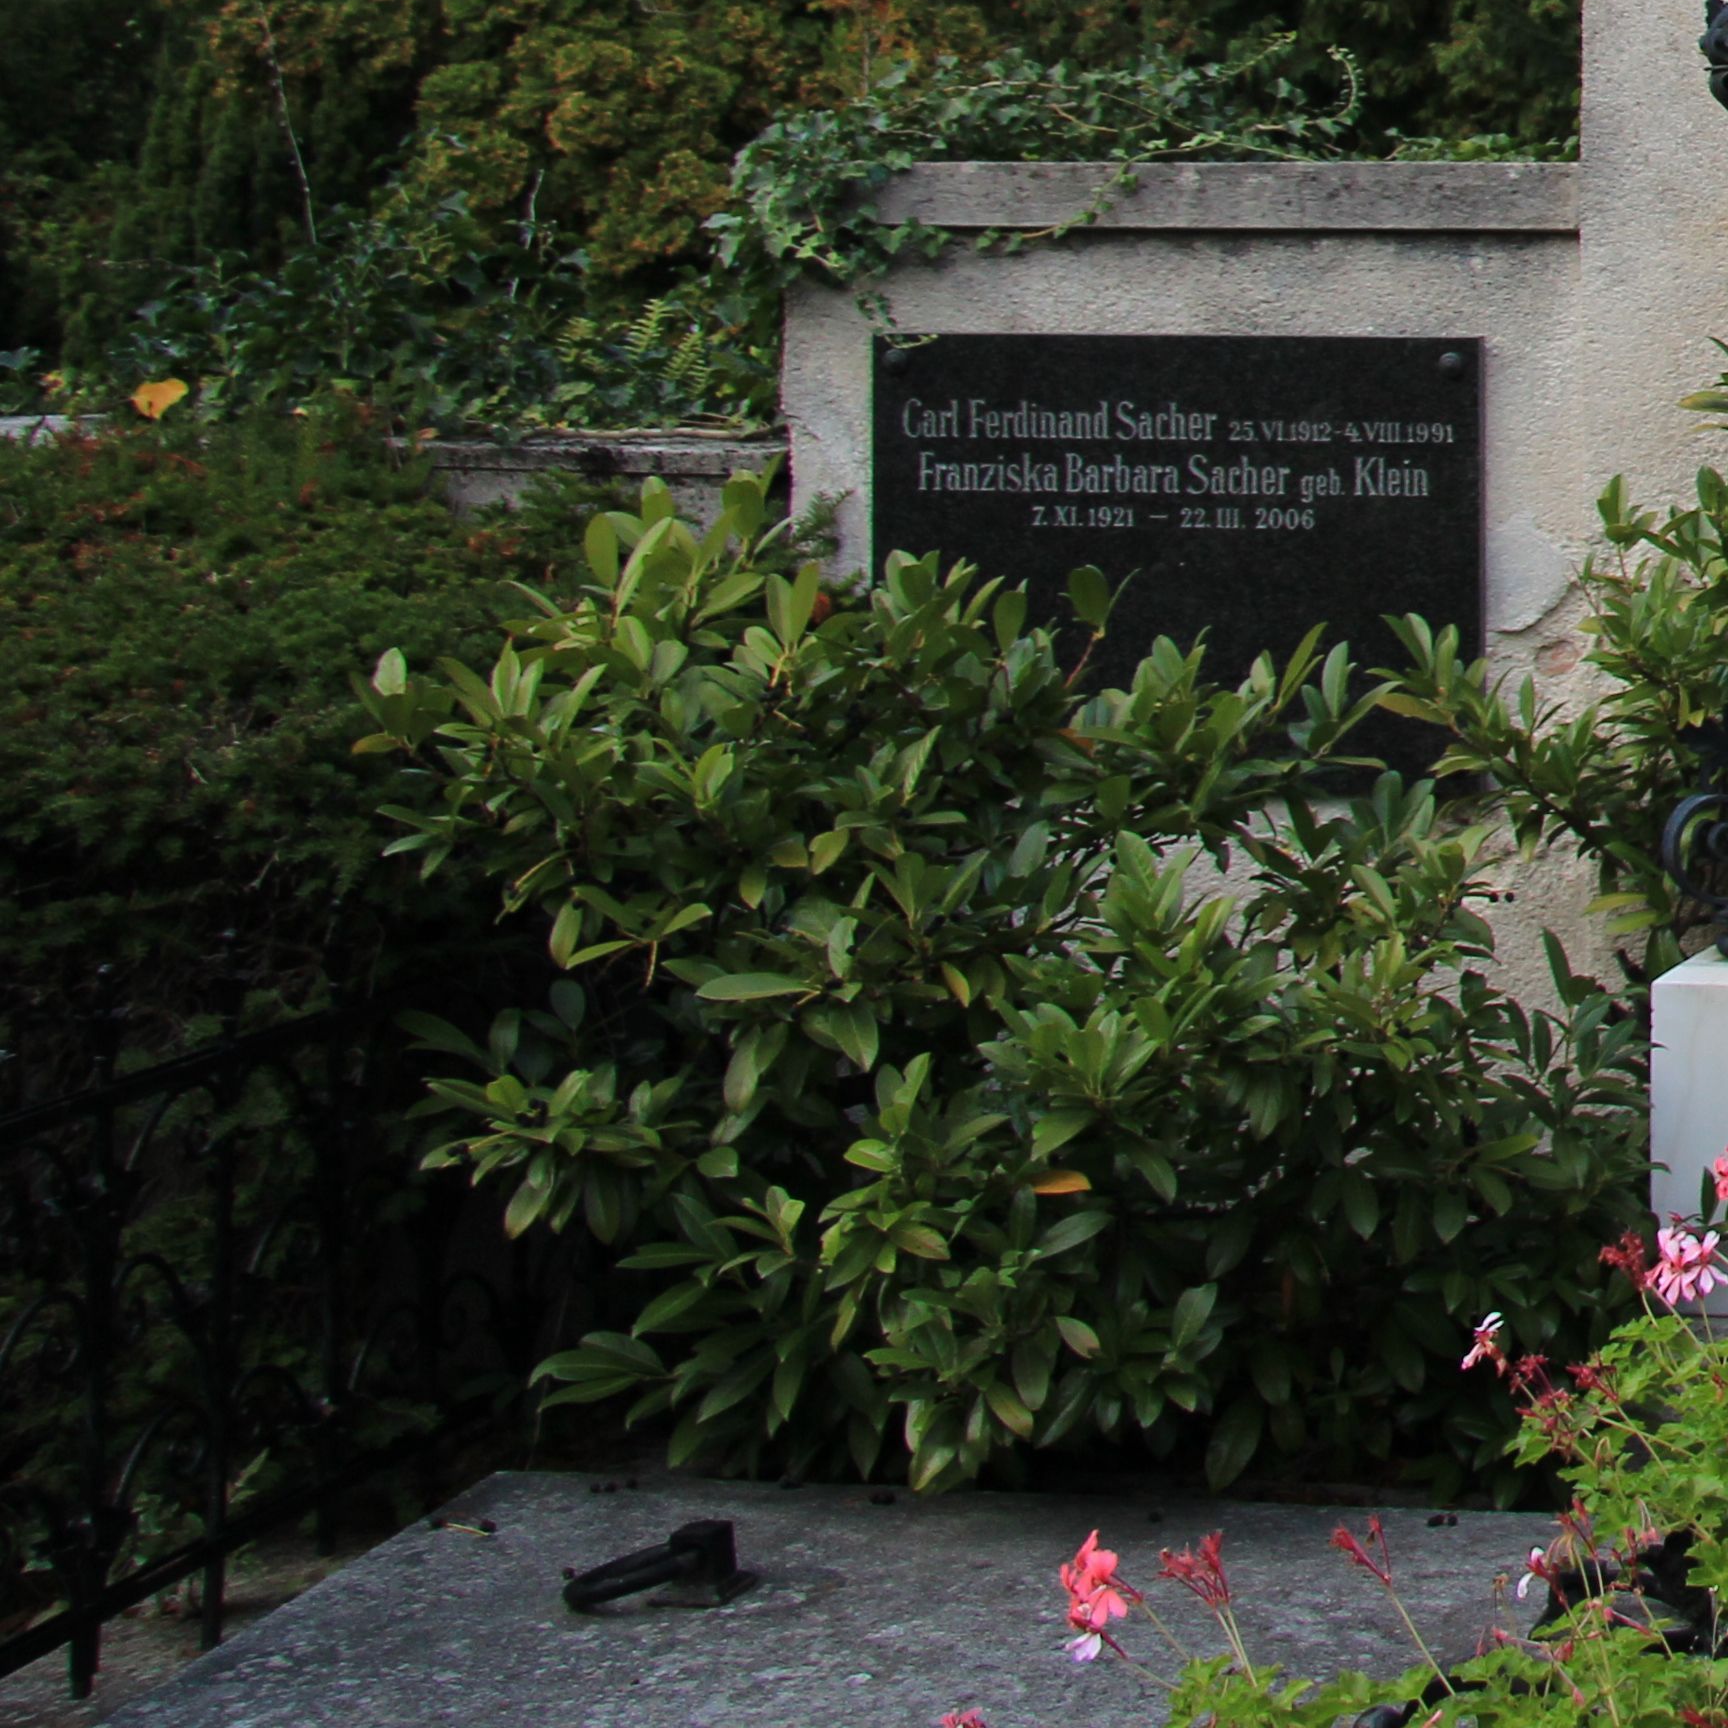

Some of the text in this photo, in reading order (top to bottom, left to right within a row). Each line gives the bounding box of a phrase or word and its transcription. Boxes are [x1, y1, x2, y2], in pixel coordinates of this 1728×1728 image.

[902, 398, 958, 438] Carl
[969, 398, 1108, 439] Ferdinand
[1115, 400, 1217, 440] Sacher
[917, 451, 1429, 503] Franziska Barbara Sacher geb. Klein
